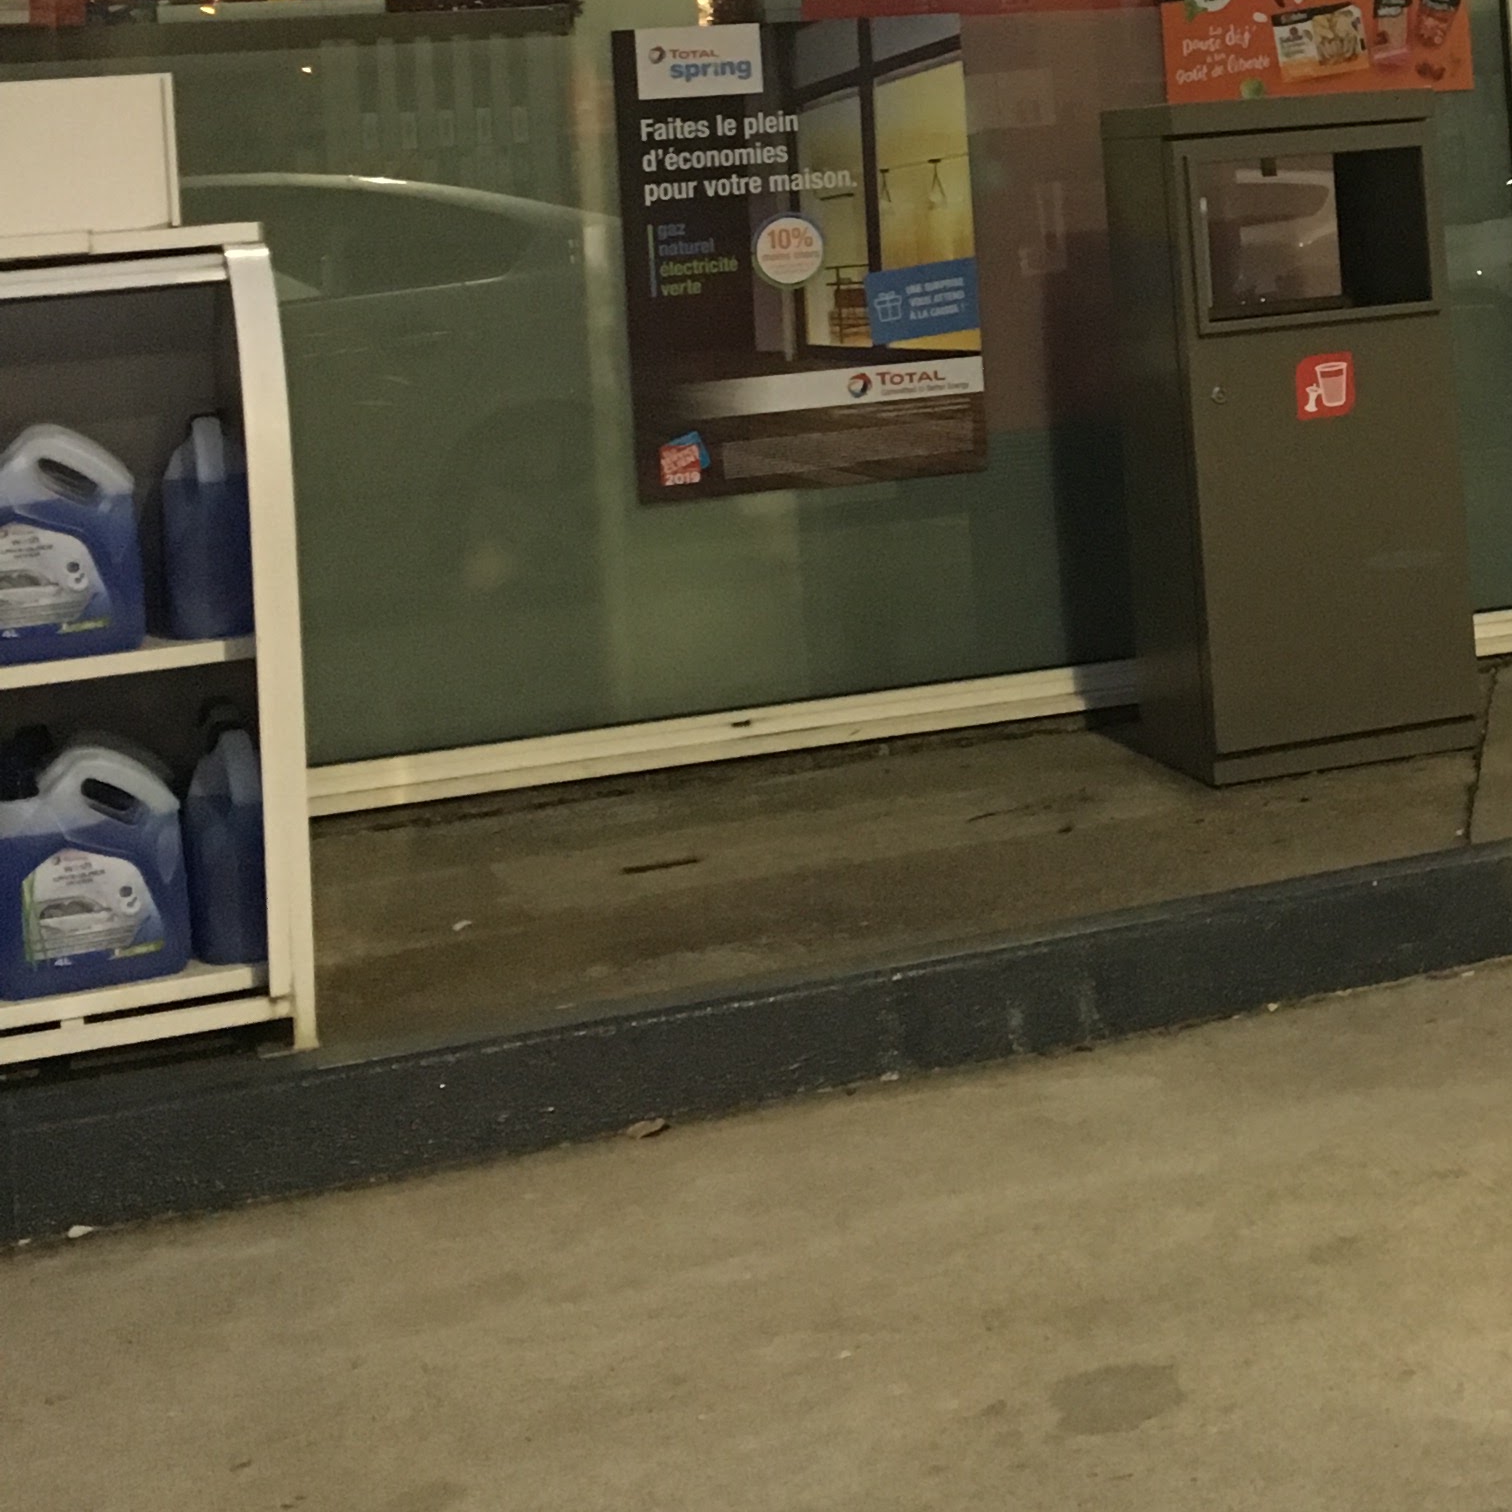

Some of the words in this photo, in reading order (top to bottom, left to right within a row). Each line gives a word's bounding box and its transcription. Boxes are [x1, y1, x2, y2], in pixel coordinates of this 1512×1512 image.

[669, 49, 720, 60] TOTAL
[669, 59, 752, 83] spring
[640, 117, 710, 142] Faites
[716, 114, 737, 137] le
[743, 110, 799, 139] plein
[642, 142, 789, 173] d'économies
[644, 180, 697, 206] pour
[703, 174, 762, 197] votre
[769, 168, 858, 193] maison.
[657, 223, 686, 240] gaz
[767, 227, 814, 249] 10%
[659, 238, 715, 256] naturel
[660, 255, 738, 277] électricité
[660, 279, 702, 296] verte
[876, 370, 946, 385] TOTAL
[665, 471, 701, 486] 2019
